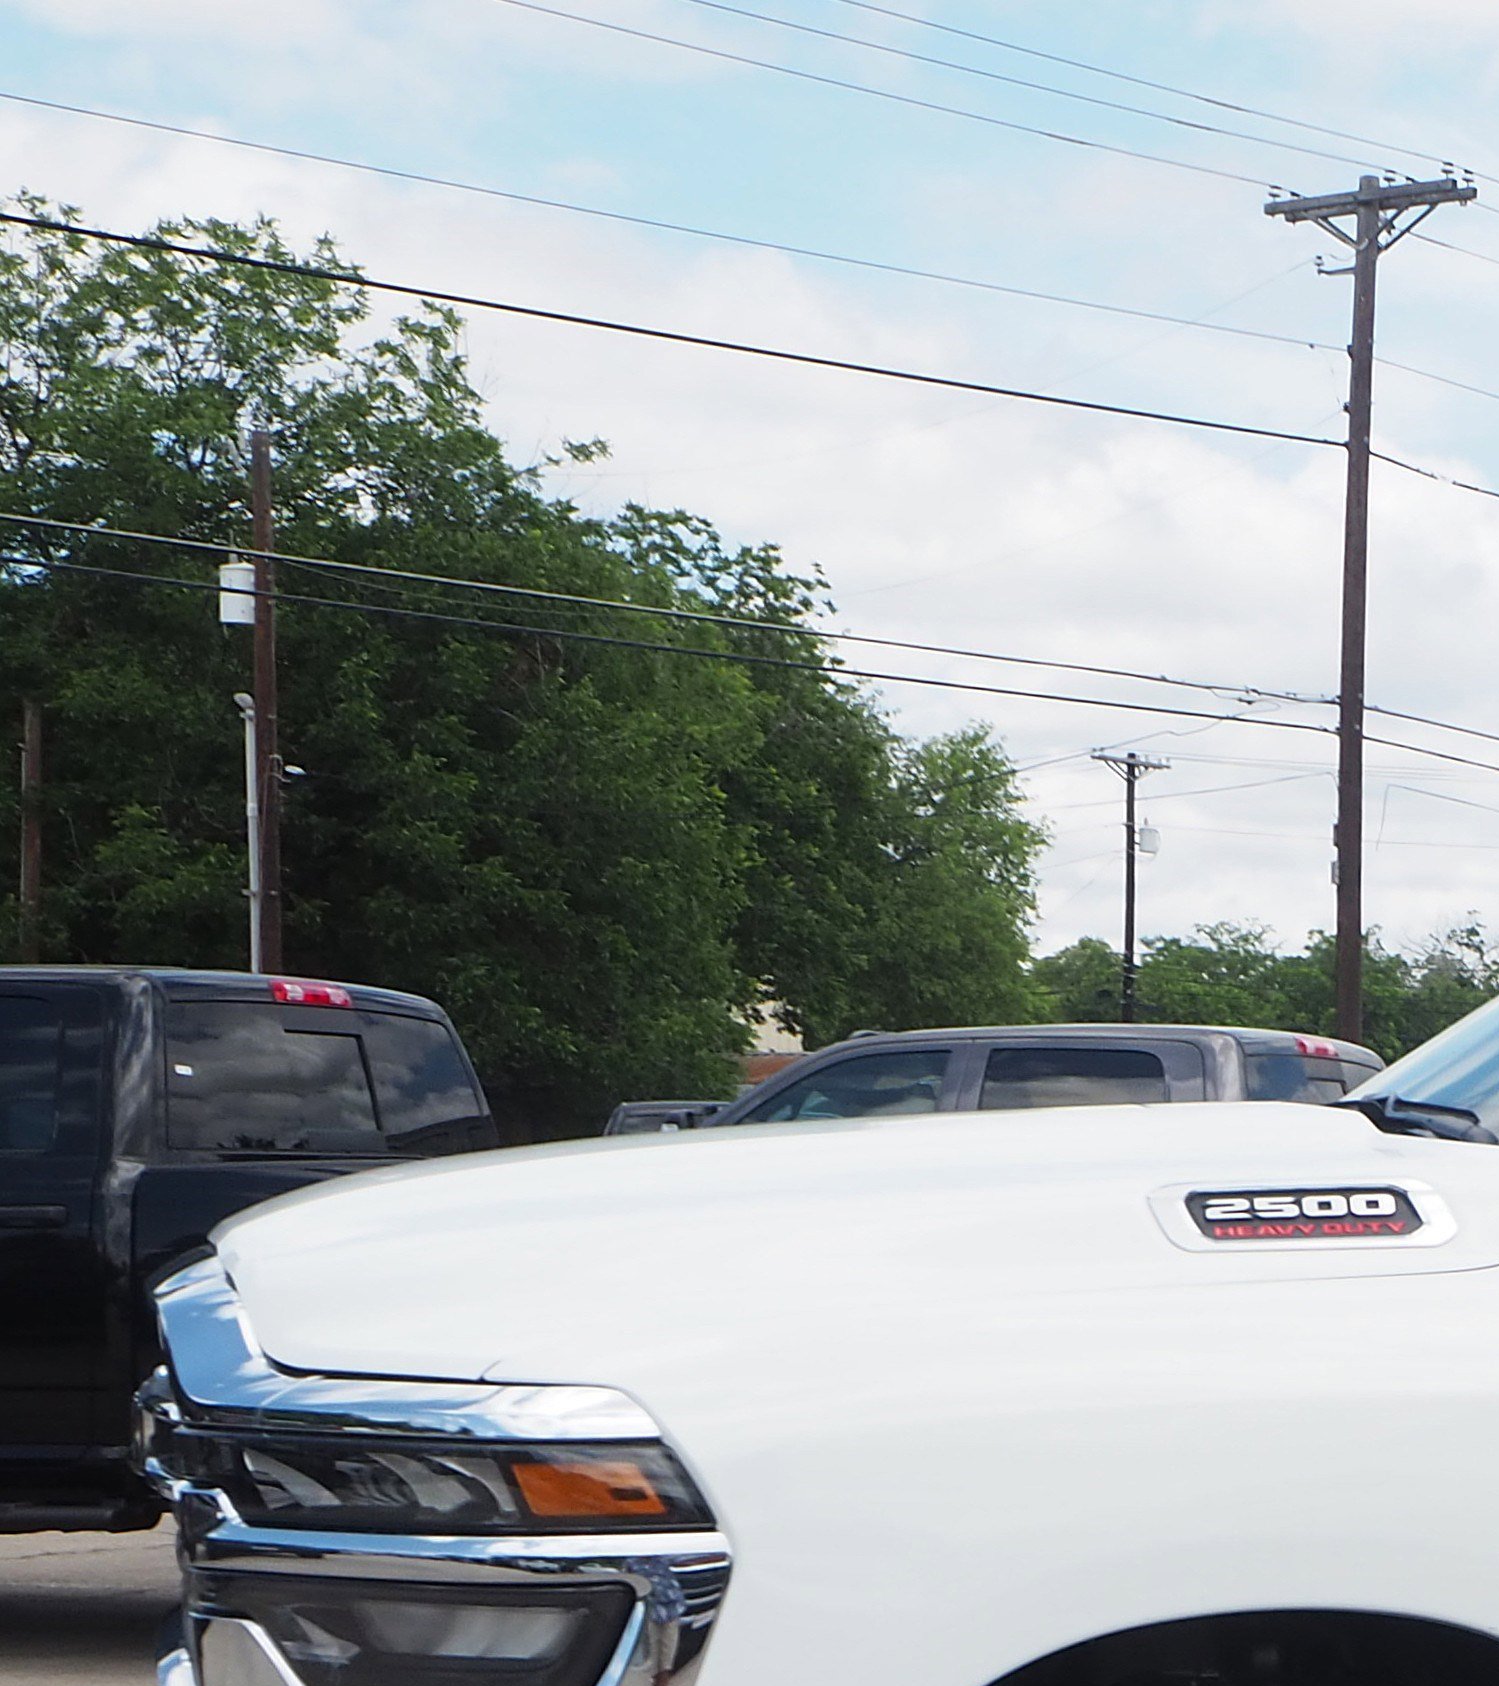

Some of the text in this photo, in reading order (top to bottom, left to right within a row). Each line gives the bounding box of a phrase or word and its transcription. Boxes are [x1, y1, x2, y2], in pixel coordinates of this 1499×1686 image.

[1204, 1193, 1397, 1220] 2500
[1212, 1221, 1406, 1239] HEAVY DUTY
